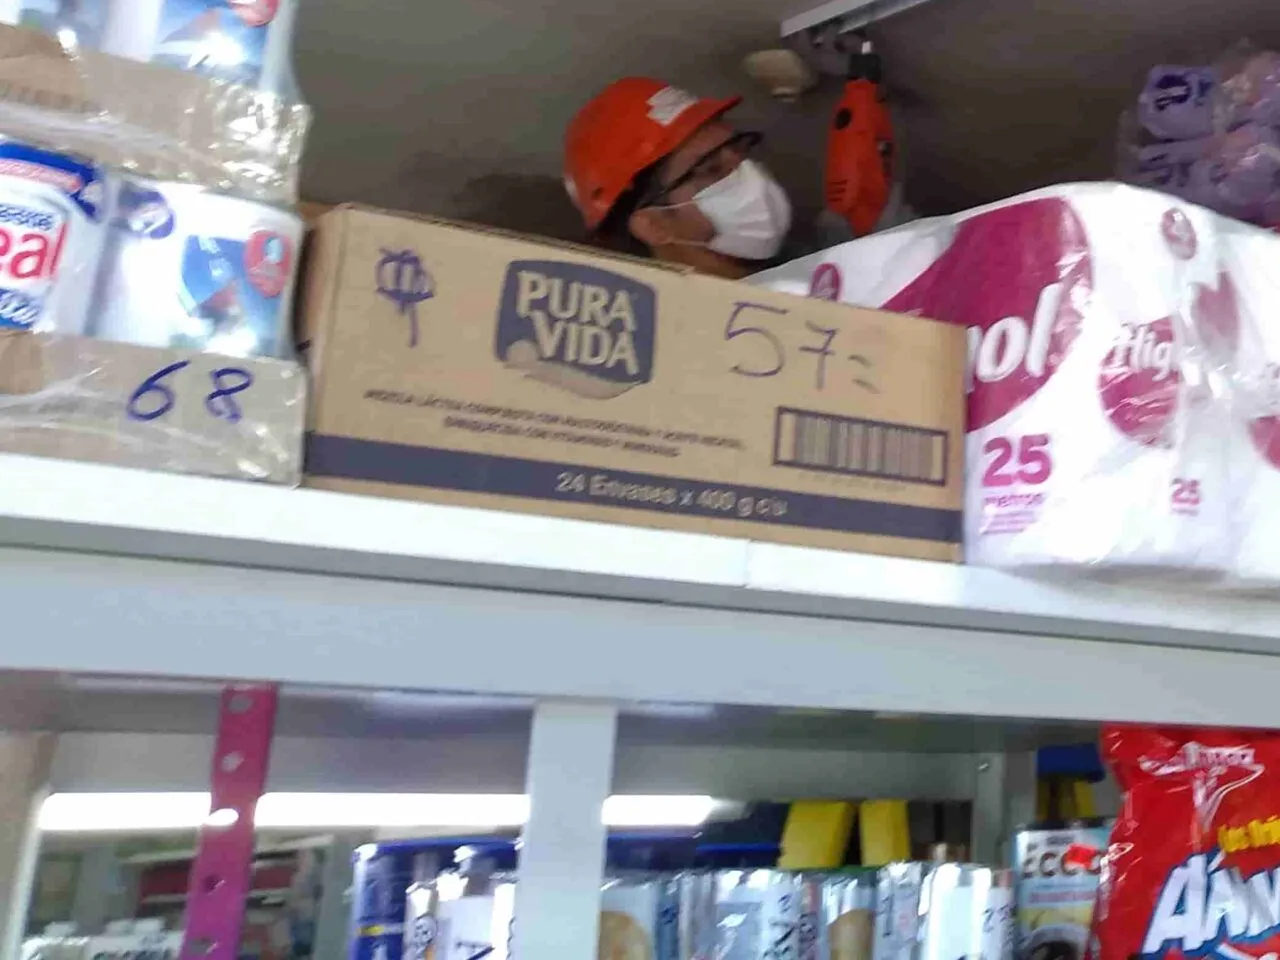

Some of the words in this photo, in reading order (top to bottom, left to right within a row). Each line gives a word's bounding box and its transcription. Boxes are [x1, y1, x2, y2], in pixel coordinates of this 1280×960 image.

[516, 270, 638, 332] PURA
[531, 310, 640, 376] VIDA
[555, 471, 586, 493] 24
[589, 473, 677, 506] Envases
[982, 433, 1052, 487] 25
